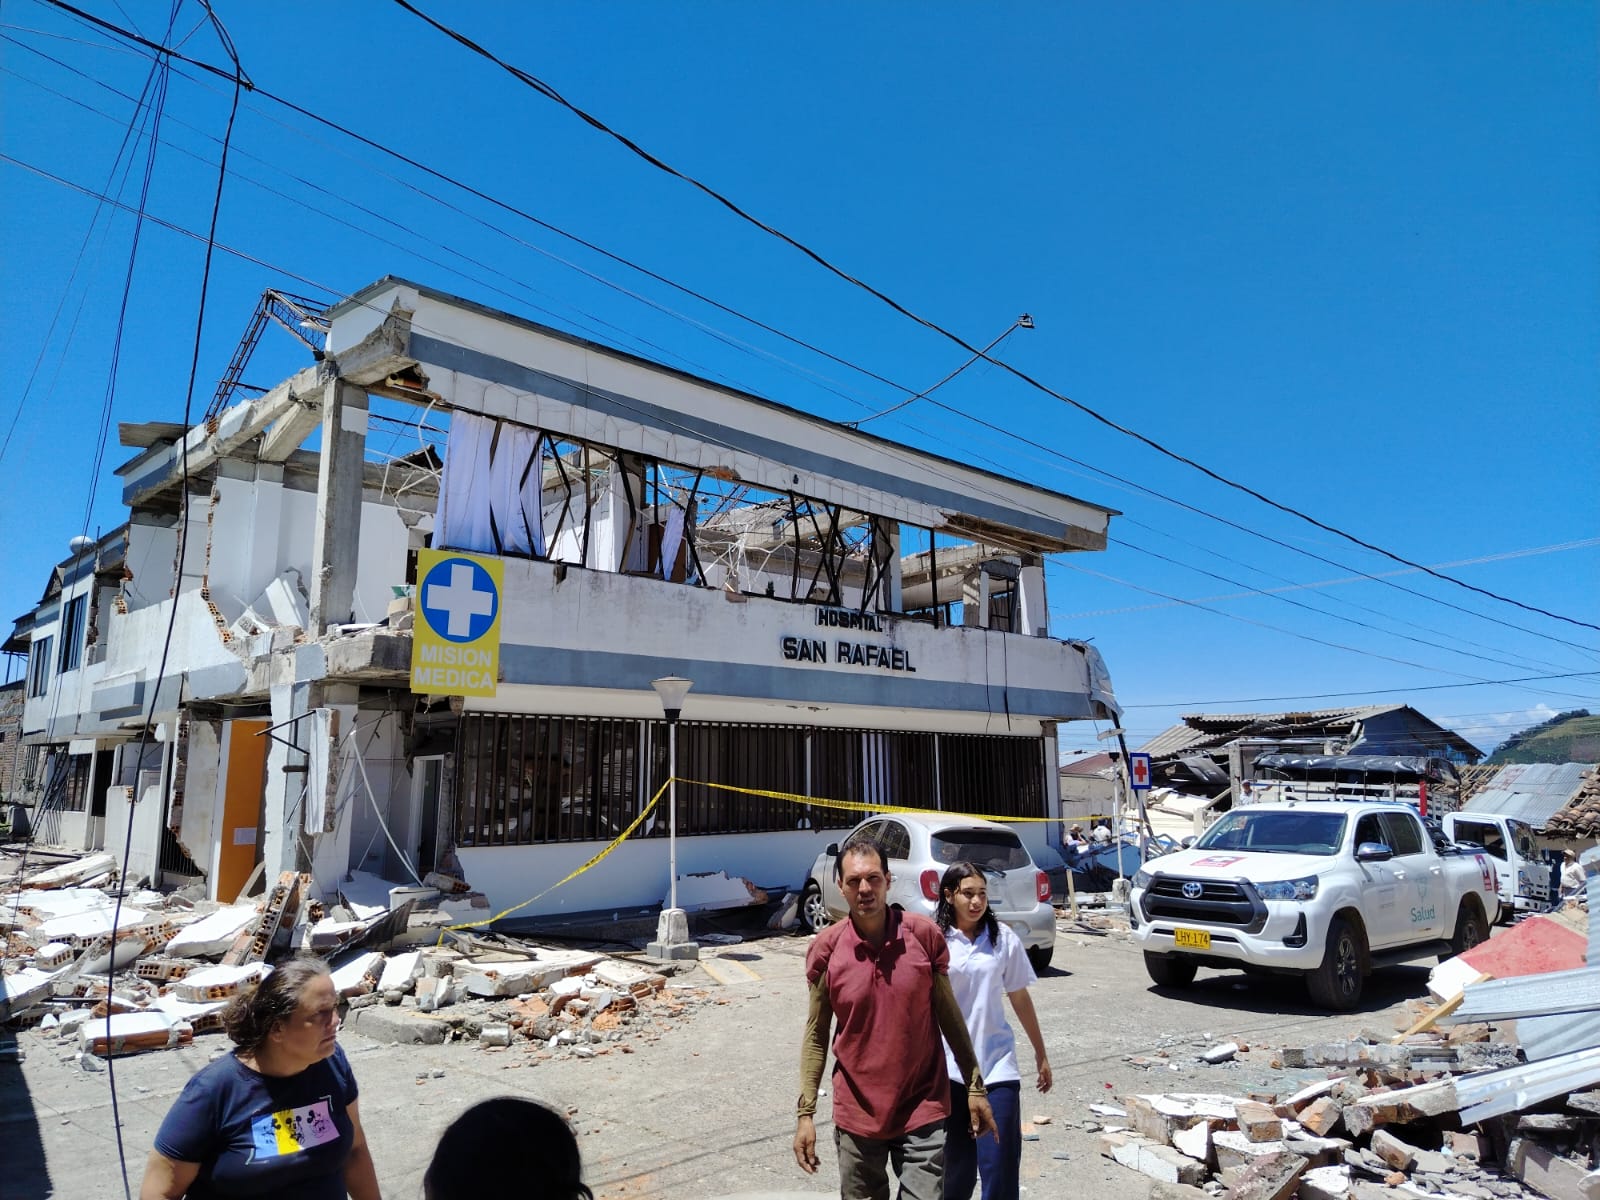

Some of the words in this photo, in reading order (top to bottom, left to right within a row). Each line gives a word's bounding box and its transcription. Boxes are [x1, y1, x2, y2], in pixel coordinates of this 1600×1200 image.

[815, 607, 882, 632] HOSPITAL
[421, 645, 492, 668] MISION
[782, 637, 827, 663] SAN
[836, 641, 916, 672] RAFAEL
[414, 666, 494, 689] MEDICA
[1410, 904, 1436, 922] Salud
